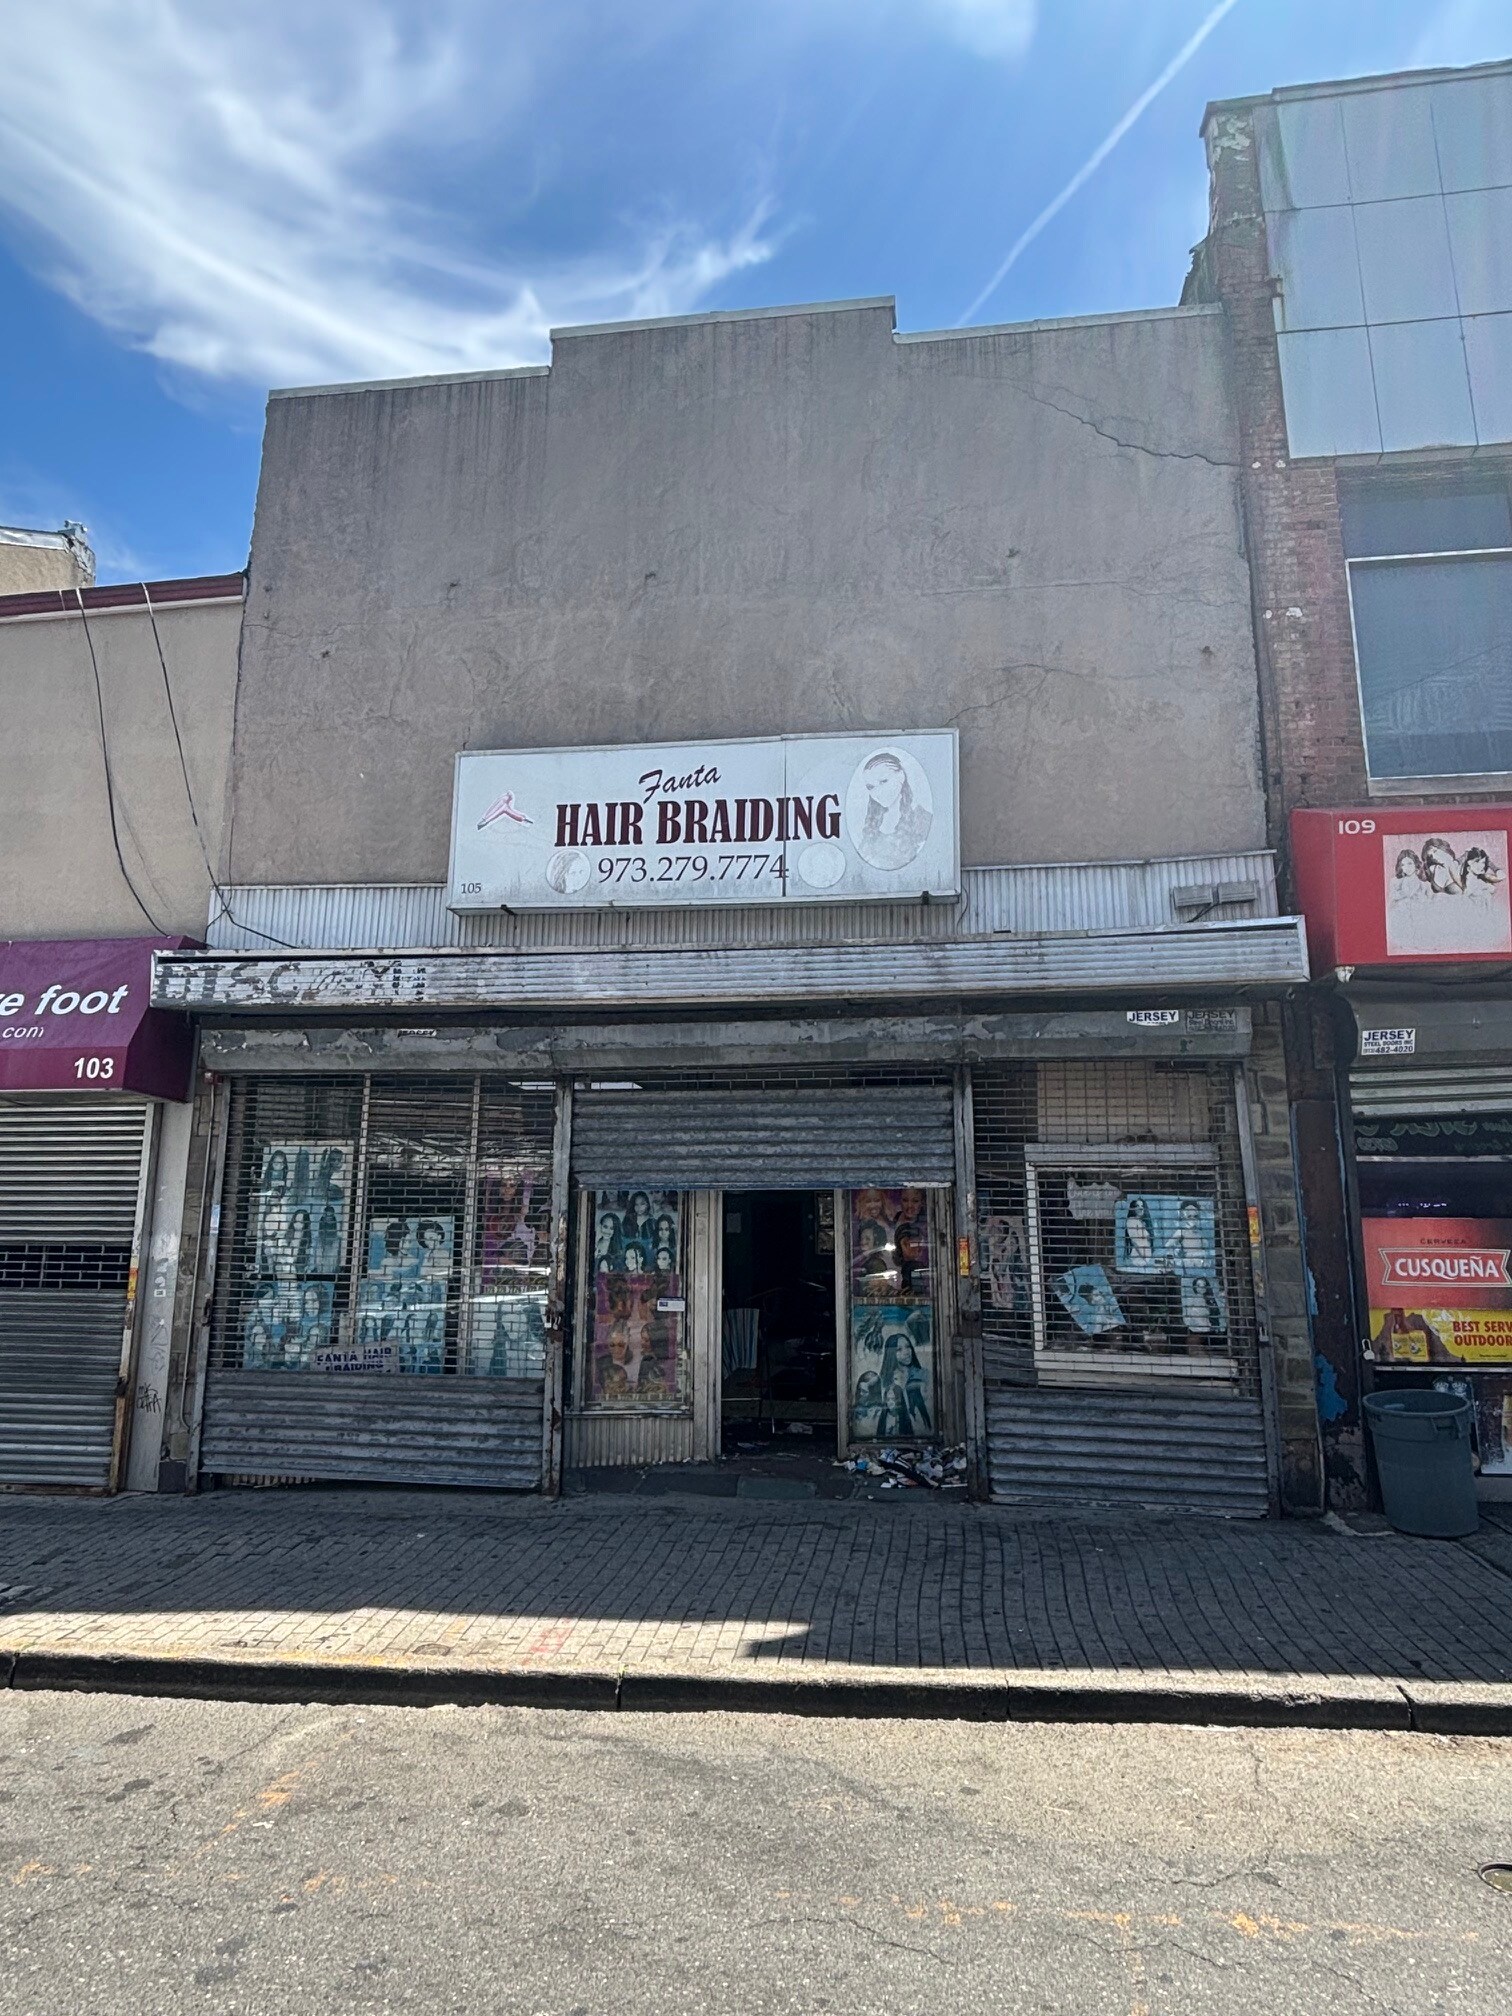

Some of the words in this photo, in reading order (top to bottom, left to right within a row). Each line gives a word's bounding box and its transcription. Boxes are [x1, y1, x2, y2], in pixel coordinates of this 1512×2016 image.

[638, 765, 722, 803] Fanta
[554, 802, 644, 847] HAIR
[655, 793, 842, 844] BRAIDING
[1338, 820, 1376, 835] 109
[598, 854, 789, 884] 973.279.7774
[460, 882, 482, 895] 105
[0, 992, 25, 1016] e
[34, 984, 129, 1015] foot
[1129, 1011, 1176, 1022] JERSEY
[1364, 1030, 1413, 1041] JERSEY
[74, 1057, 114, 1079] 103
[1395, 1256, 1499, 1280] CUSQUEÑA
[1453, 1321, 1480, 1332] BEST
